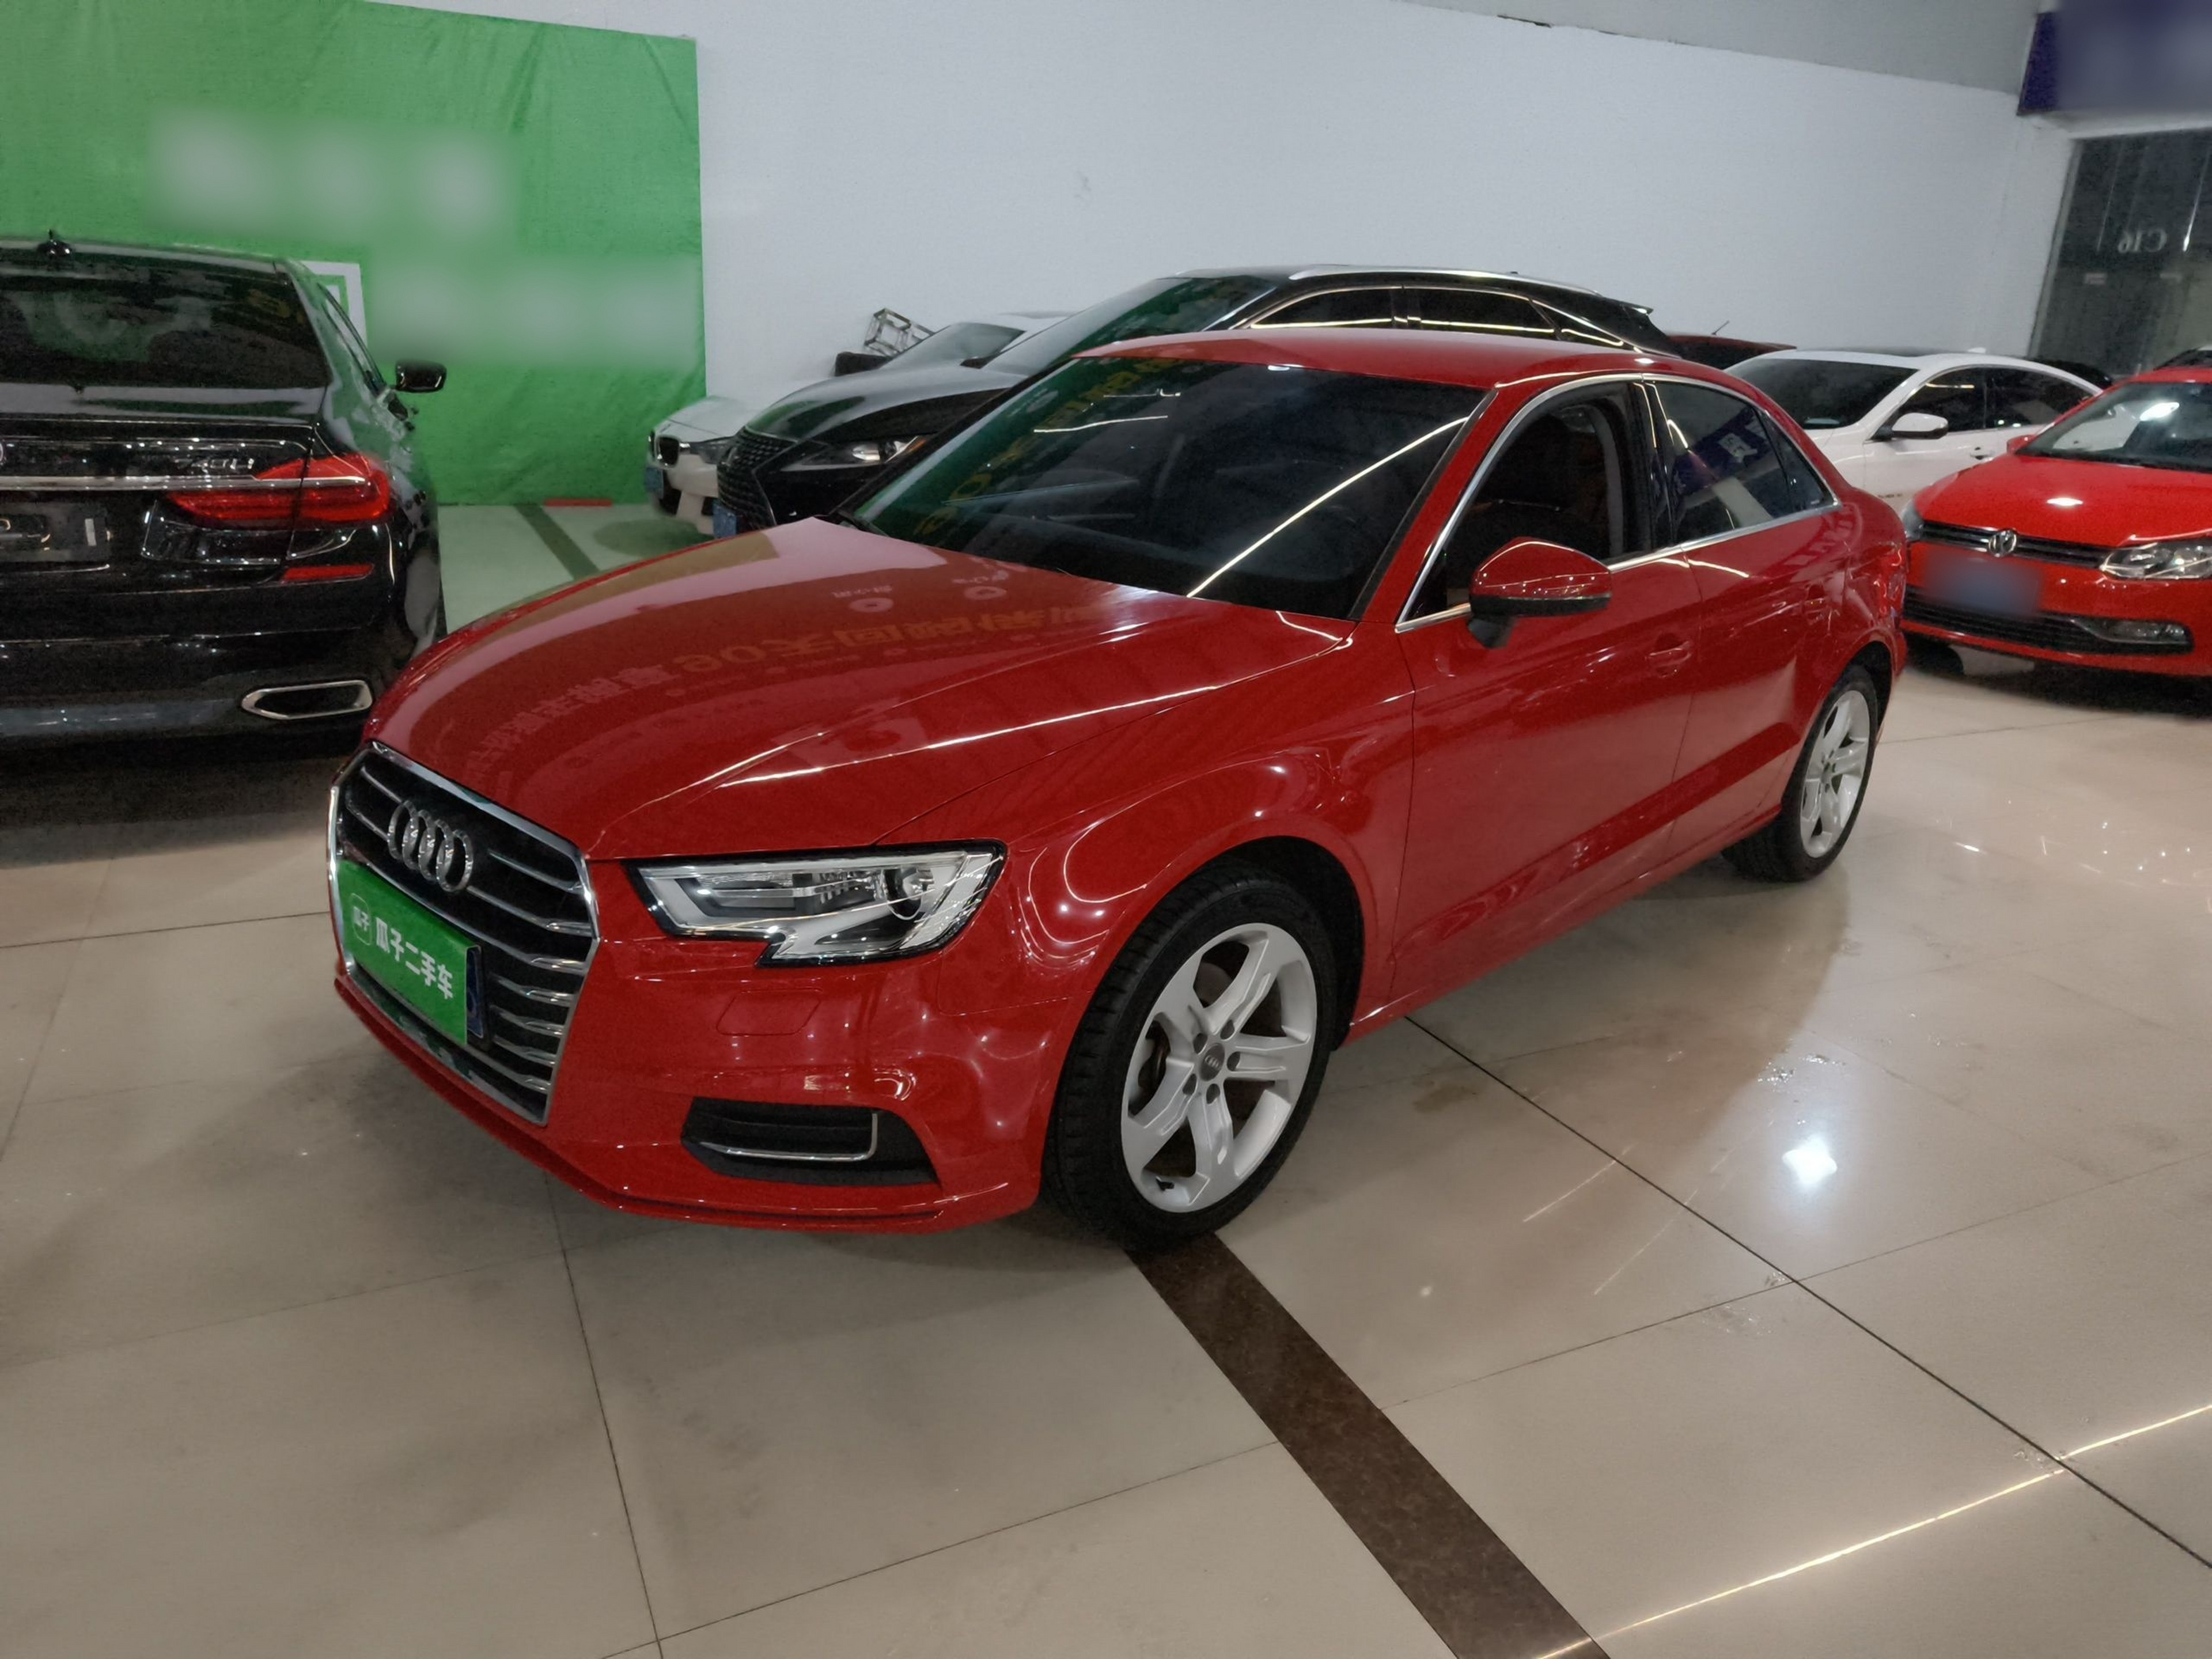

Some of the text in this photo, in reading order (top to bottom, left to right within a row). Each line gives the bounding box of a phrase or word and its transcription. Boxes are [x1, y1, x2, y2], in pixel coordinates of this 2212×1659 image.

[375, 916, 454, 1000] 瓜子二手车
